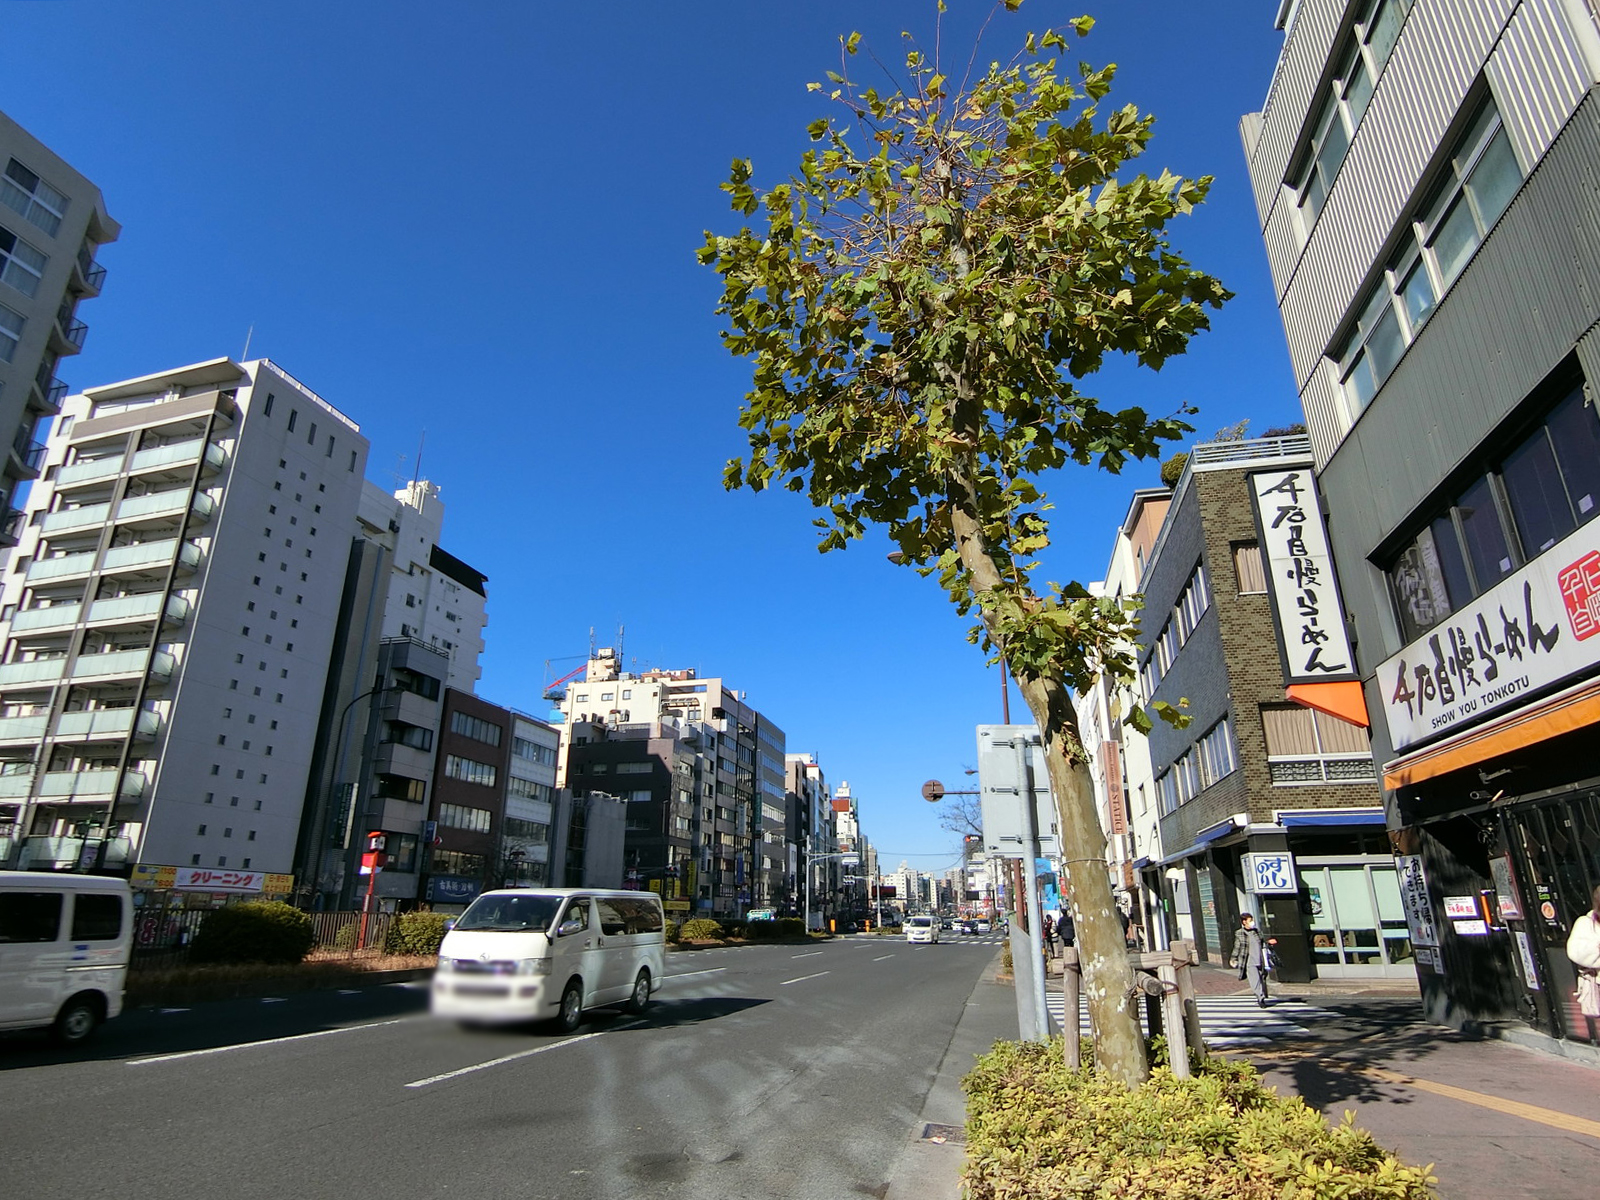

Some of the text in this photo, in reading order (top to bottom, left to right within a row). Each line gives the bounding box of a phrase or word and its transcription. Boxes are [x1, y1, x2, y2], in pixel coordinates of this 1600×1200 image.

[1260, 473, 1347, 672] 千石自慢らーめん
[1392, 580, 1560, 721] 千石自慢らーめん
[1432, 675, 1530, 729] SHOW YOU TONKOTU
[190, 870, 254, 887] クリーニング
[1264, 857, 1287, 888] すし
[1403, 865, 1421, 921] できます
